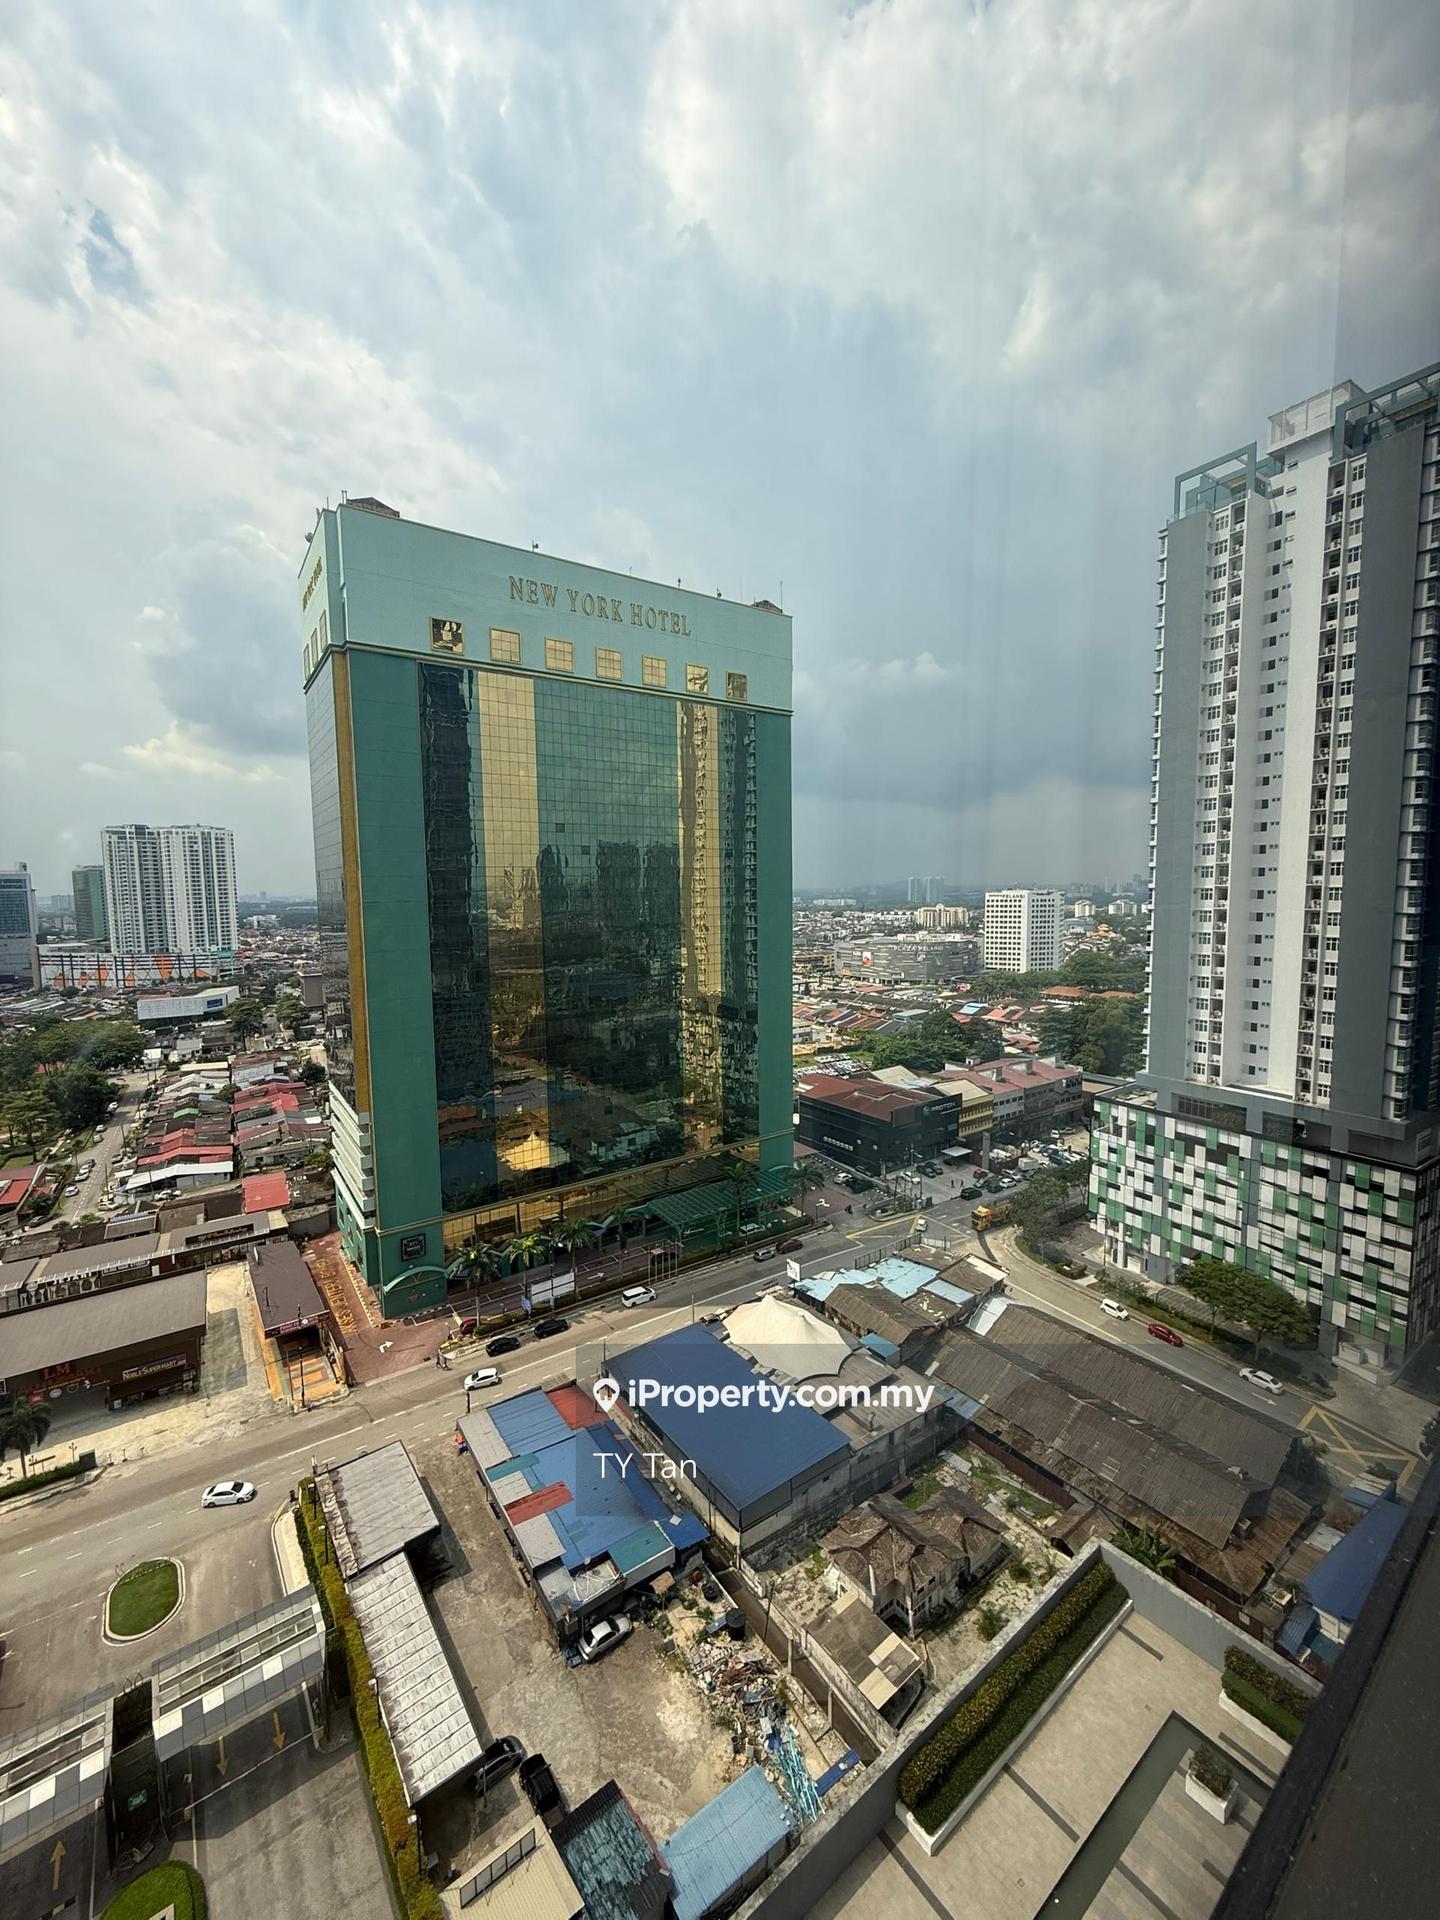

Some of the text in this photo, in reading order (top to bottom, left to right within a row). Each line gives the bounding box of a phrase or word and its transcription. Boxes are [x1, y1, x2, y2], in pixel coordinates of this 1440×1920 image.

[509, 575, 691, 637] NEW YORK HOTEL
